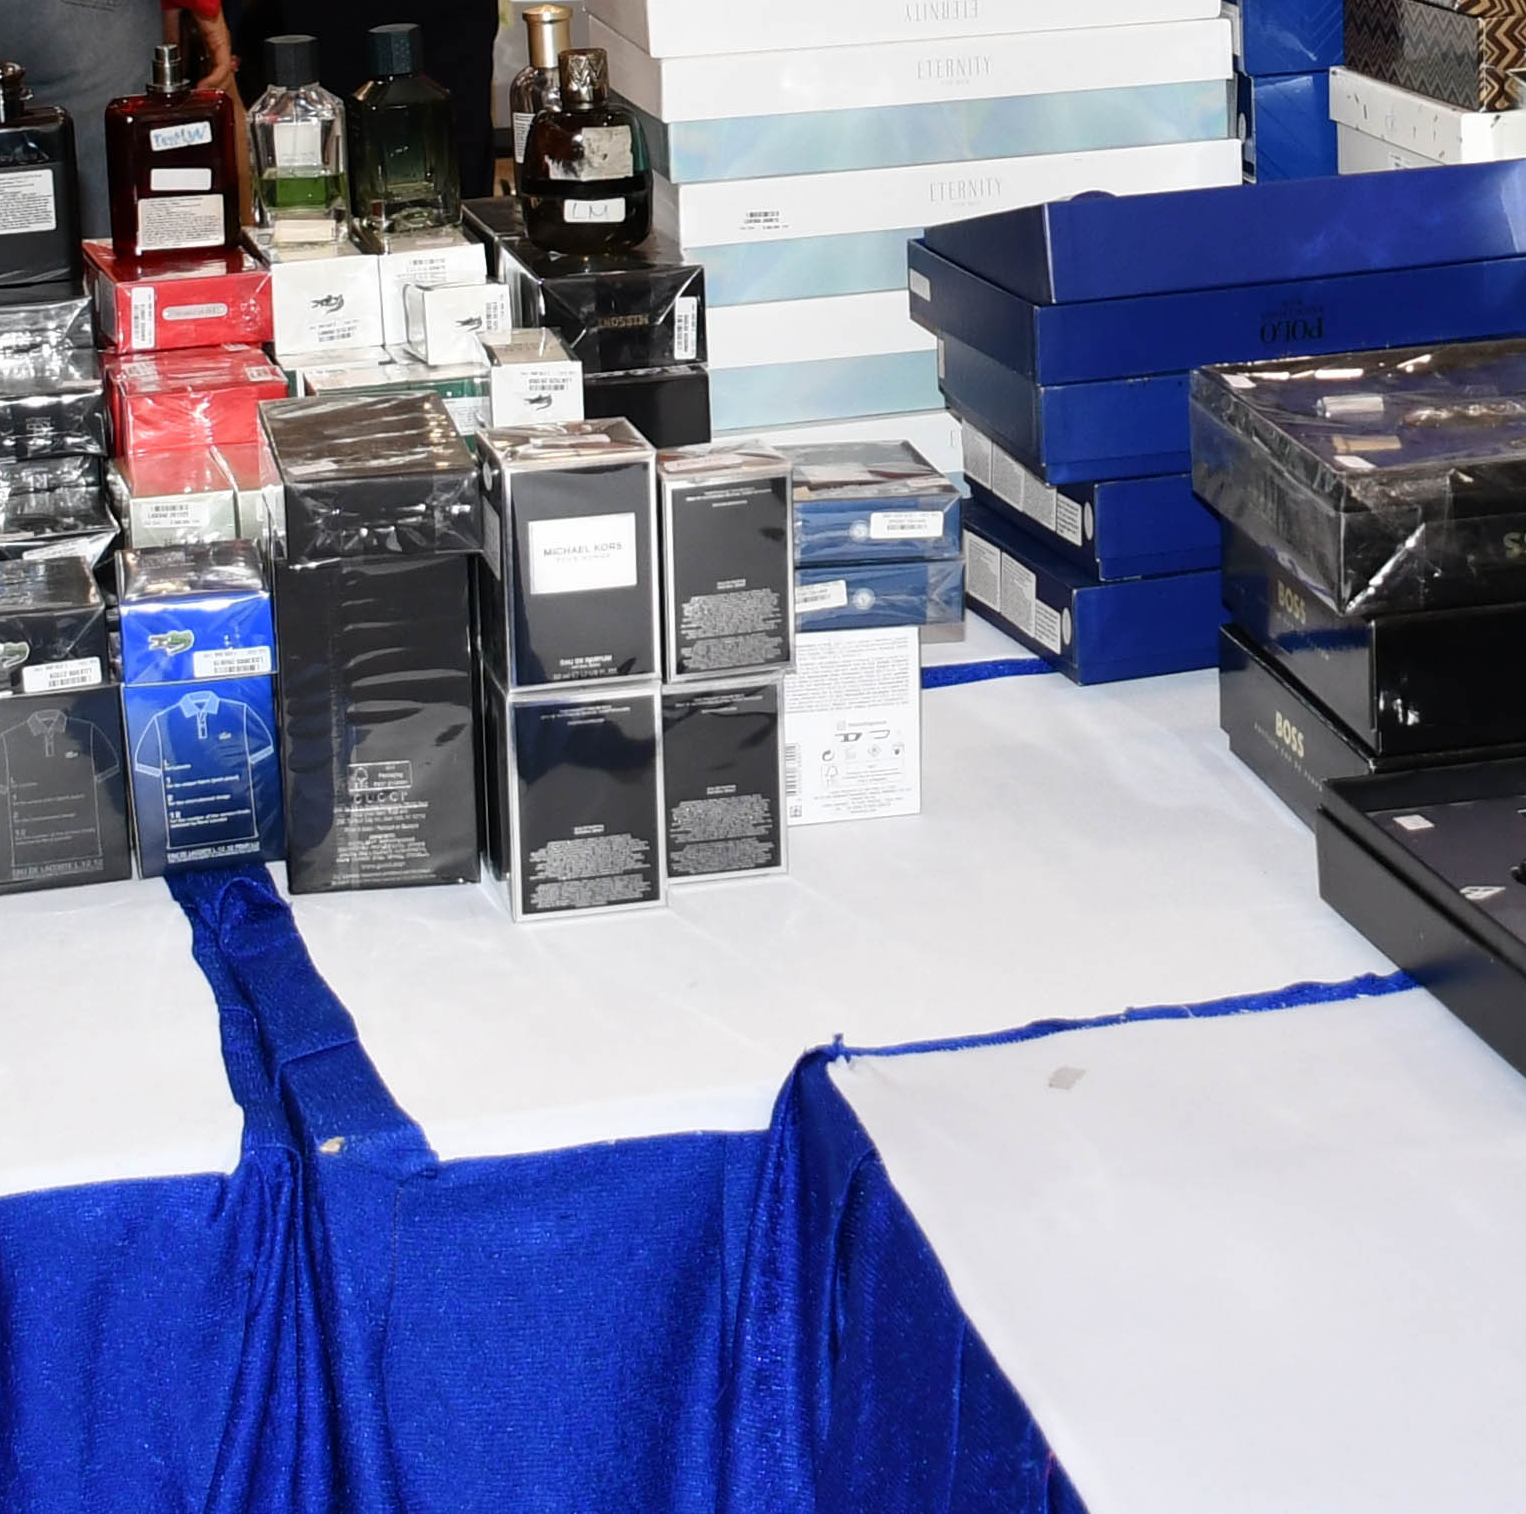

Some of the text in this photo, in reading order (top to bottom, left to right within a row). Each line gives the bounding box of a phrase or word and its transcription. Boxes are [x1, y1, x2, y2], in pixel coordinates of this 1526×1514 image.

[916, 53, 993, 80] ETERNITY
[929, 177, 1003, 203] ETERNITY
[1259, 317, 1323, 343] POLO
[543, 541, 623, 557] MICHAEL KORS
[1277, 579, 1307, 625] BOSS
[1275, 710, 1305, 758] BOSS
